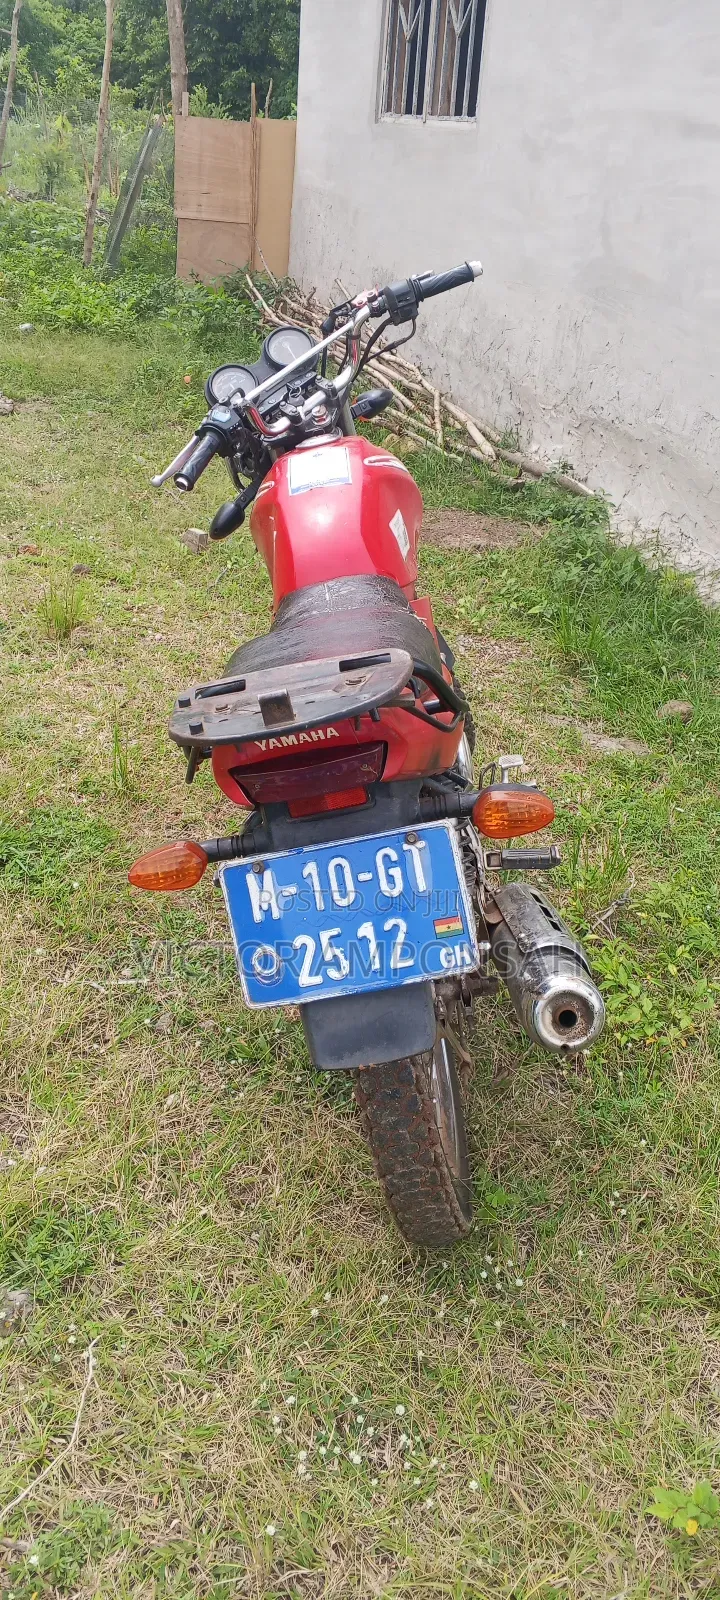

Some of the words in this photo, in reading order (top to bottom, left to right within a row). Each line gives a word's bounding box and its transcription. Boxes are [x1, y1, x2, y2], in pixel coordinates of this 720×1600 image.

[253, 726, 340, 752] YAMAHA
[245, 839, 428, 925] M-10-GT
[291, 917, 415, 988] 2512
[439, 943, 473, 969] GH
